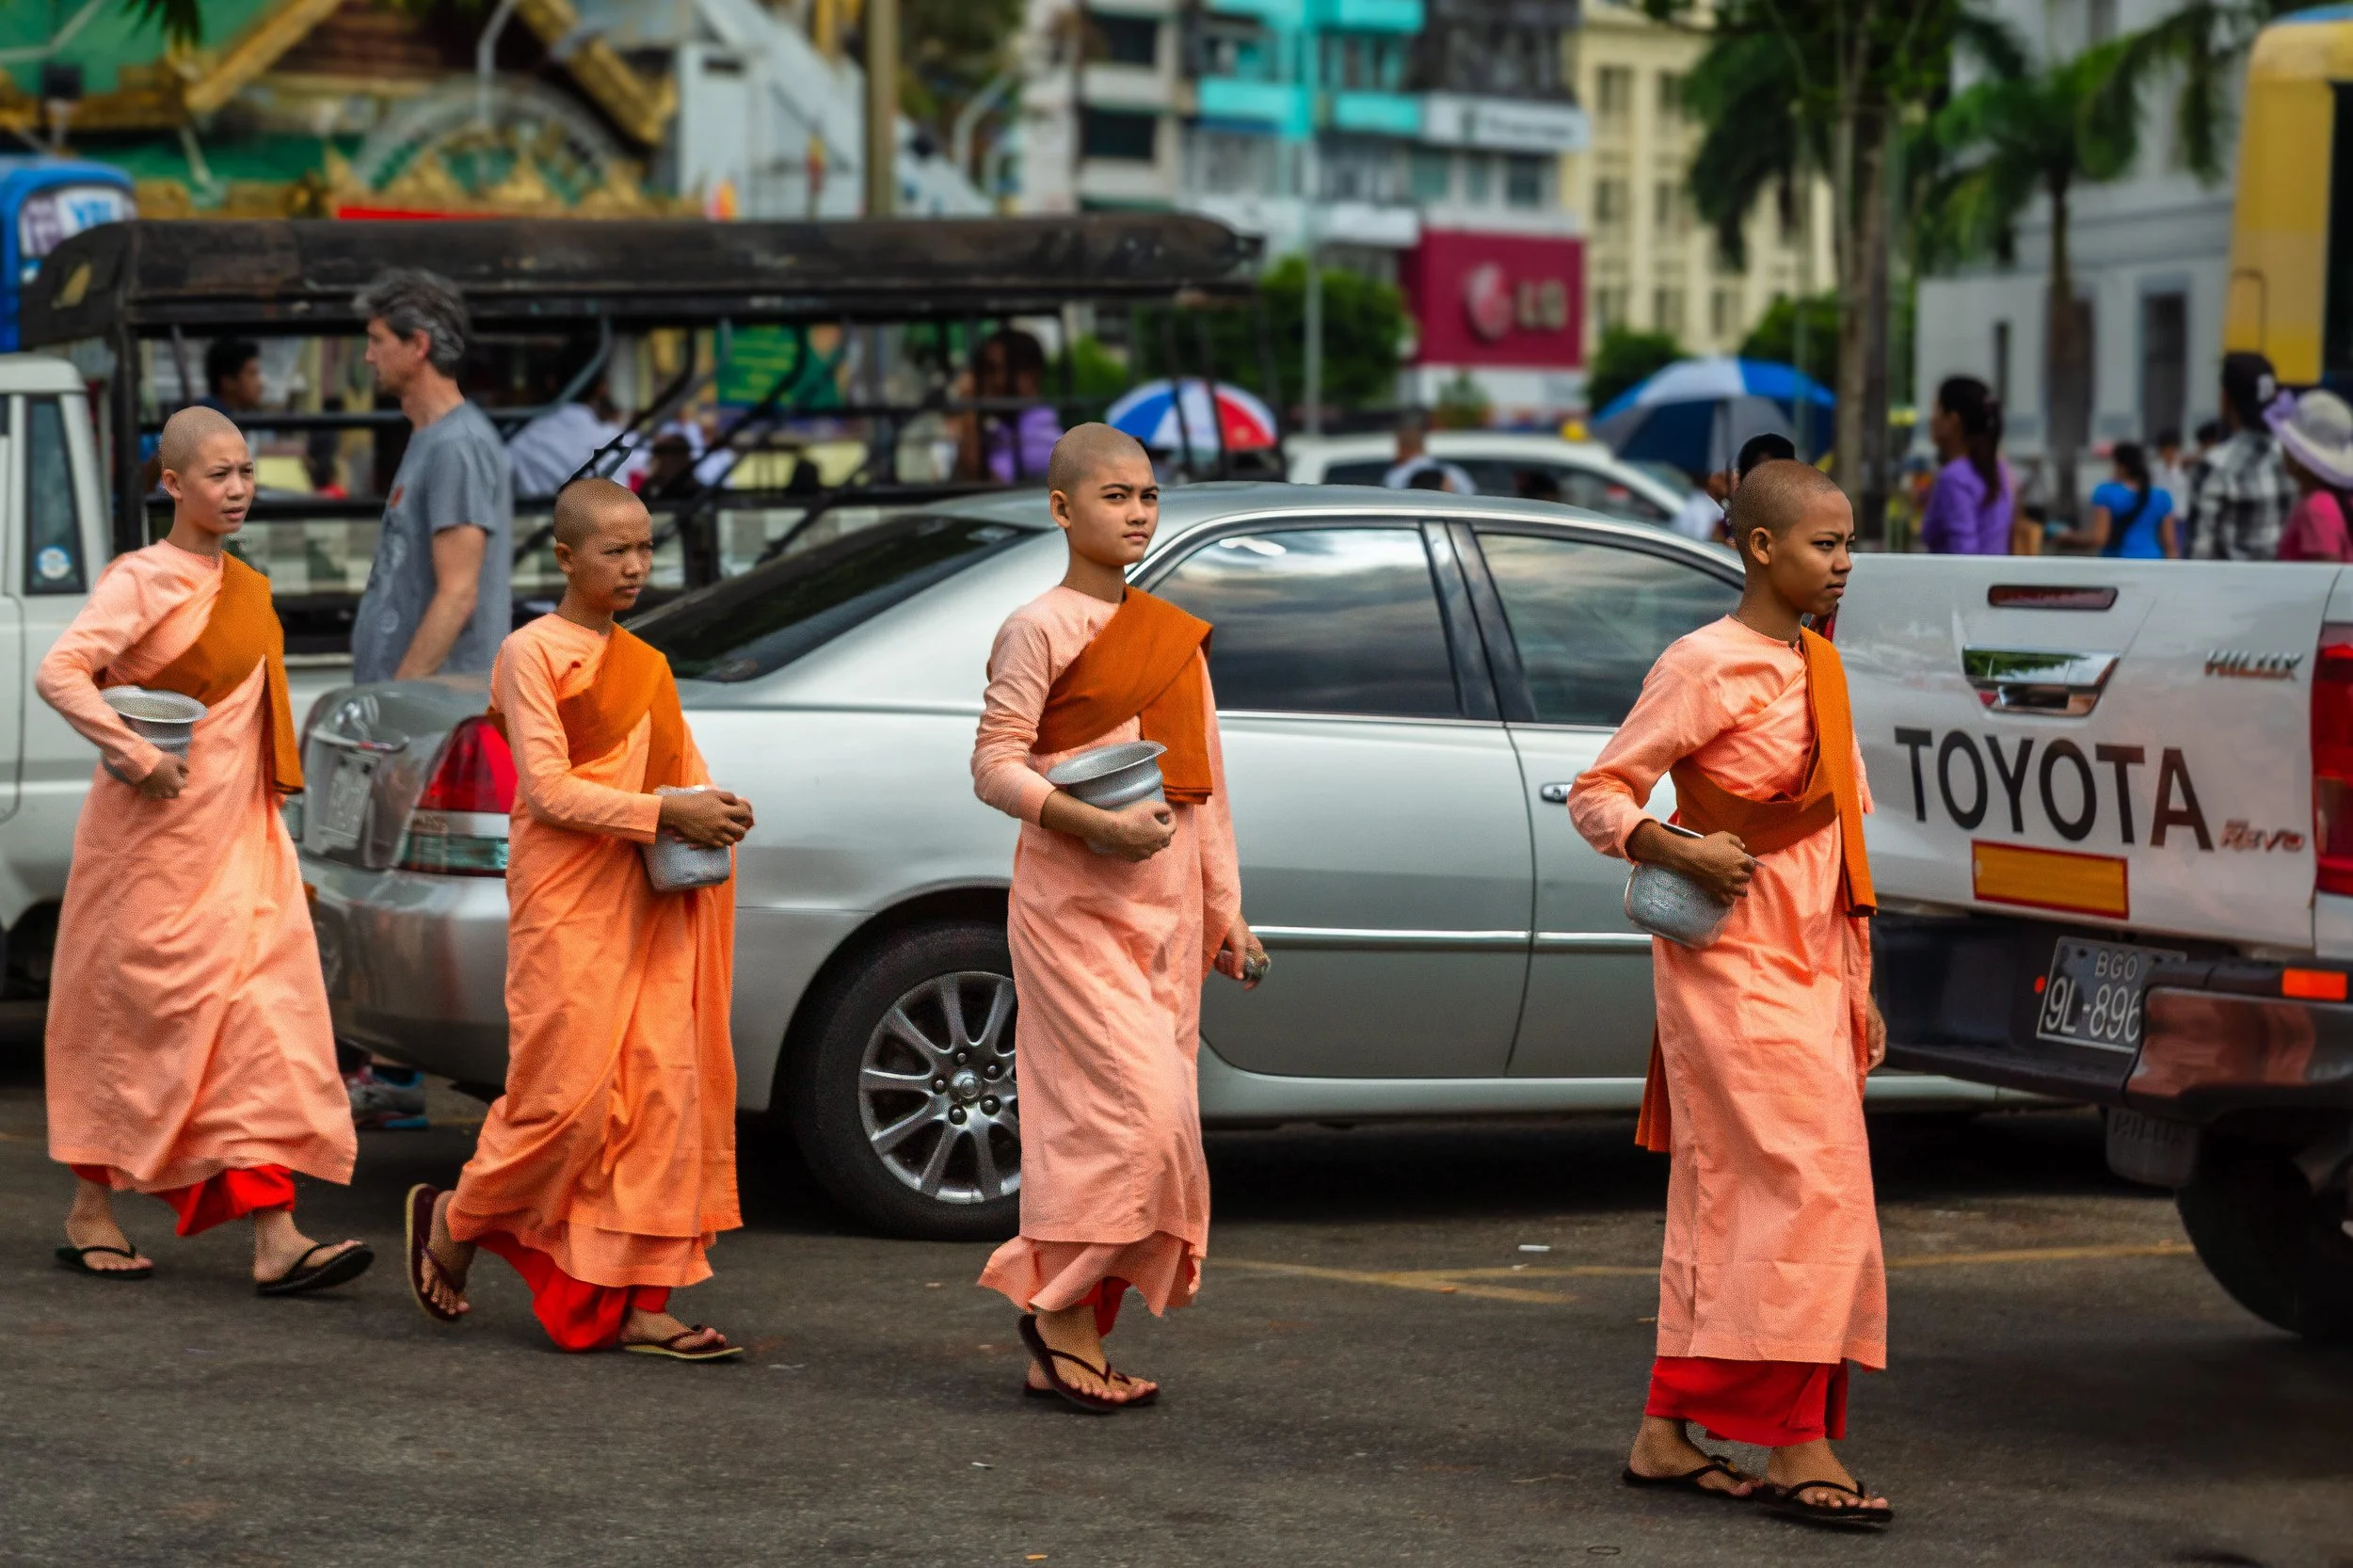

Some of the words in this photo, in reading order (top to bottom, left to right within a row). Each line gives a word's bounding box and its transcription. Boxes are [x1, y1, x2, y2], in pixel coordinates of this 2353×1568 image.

[1515, 278, 1569, 331] LG
[2204, 648, 2303, 680] HILUX
[1895, 726, 2215, 852] TOYOTA
[2095, 951, 2137, 982] BGO
[2045, 976, 2142, 1043] 9L-896
